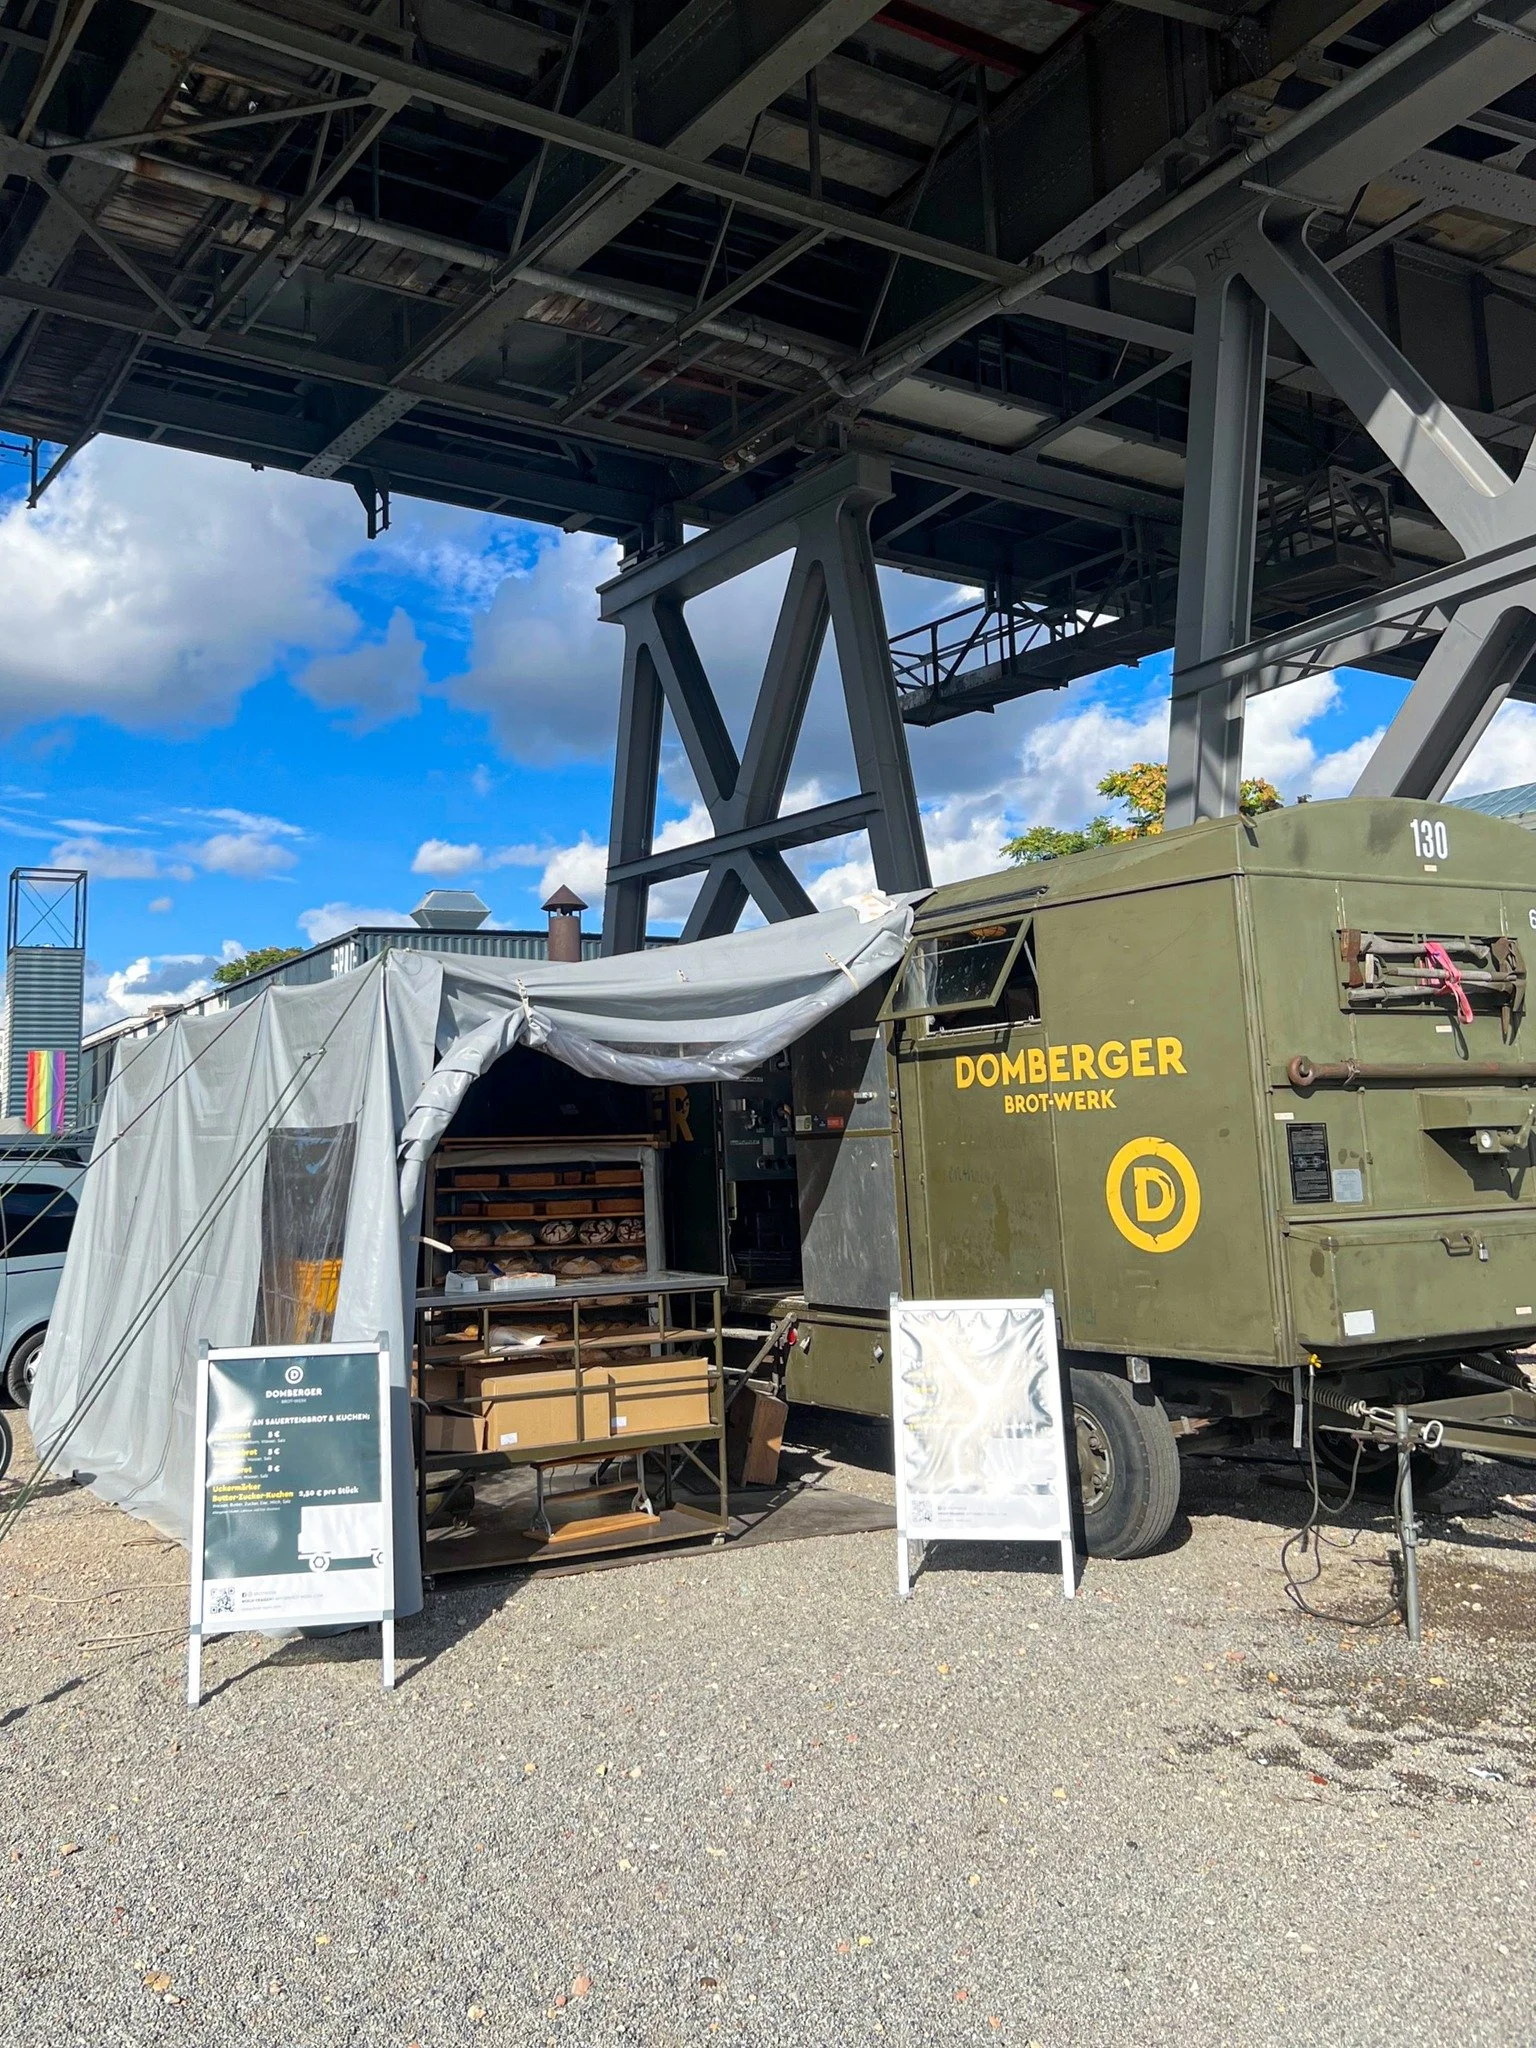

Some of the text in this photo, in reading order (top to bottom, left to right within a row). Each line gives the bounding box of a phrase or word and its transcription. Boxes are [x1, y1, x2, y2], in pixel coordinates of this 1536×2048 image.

[1410, 819, 1448, 859] 130
[955, 1036, 1187, 1089] DOMBERGER
[265, 1388, 322, 1399] DOMBERGER
[252, 1418, 264, 1426] AN
[265, 1415, 328, 1426] SAUERTEIGBROT
[212, 1490, 294, 1502] Butter-Zucker-Kuchen
[298, 1490, 315, 1498] 2,50
[323, 1489, 337, 1497] pro
[337, 1485, 359, 1495] Stück
[213, 1483, 261, 1493] Uckermärker
